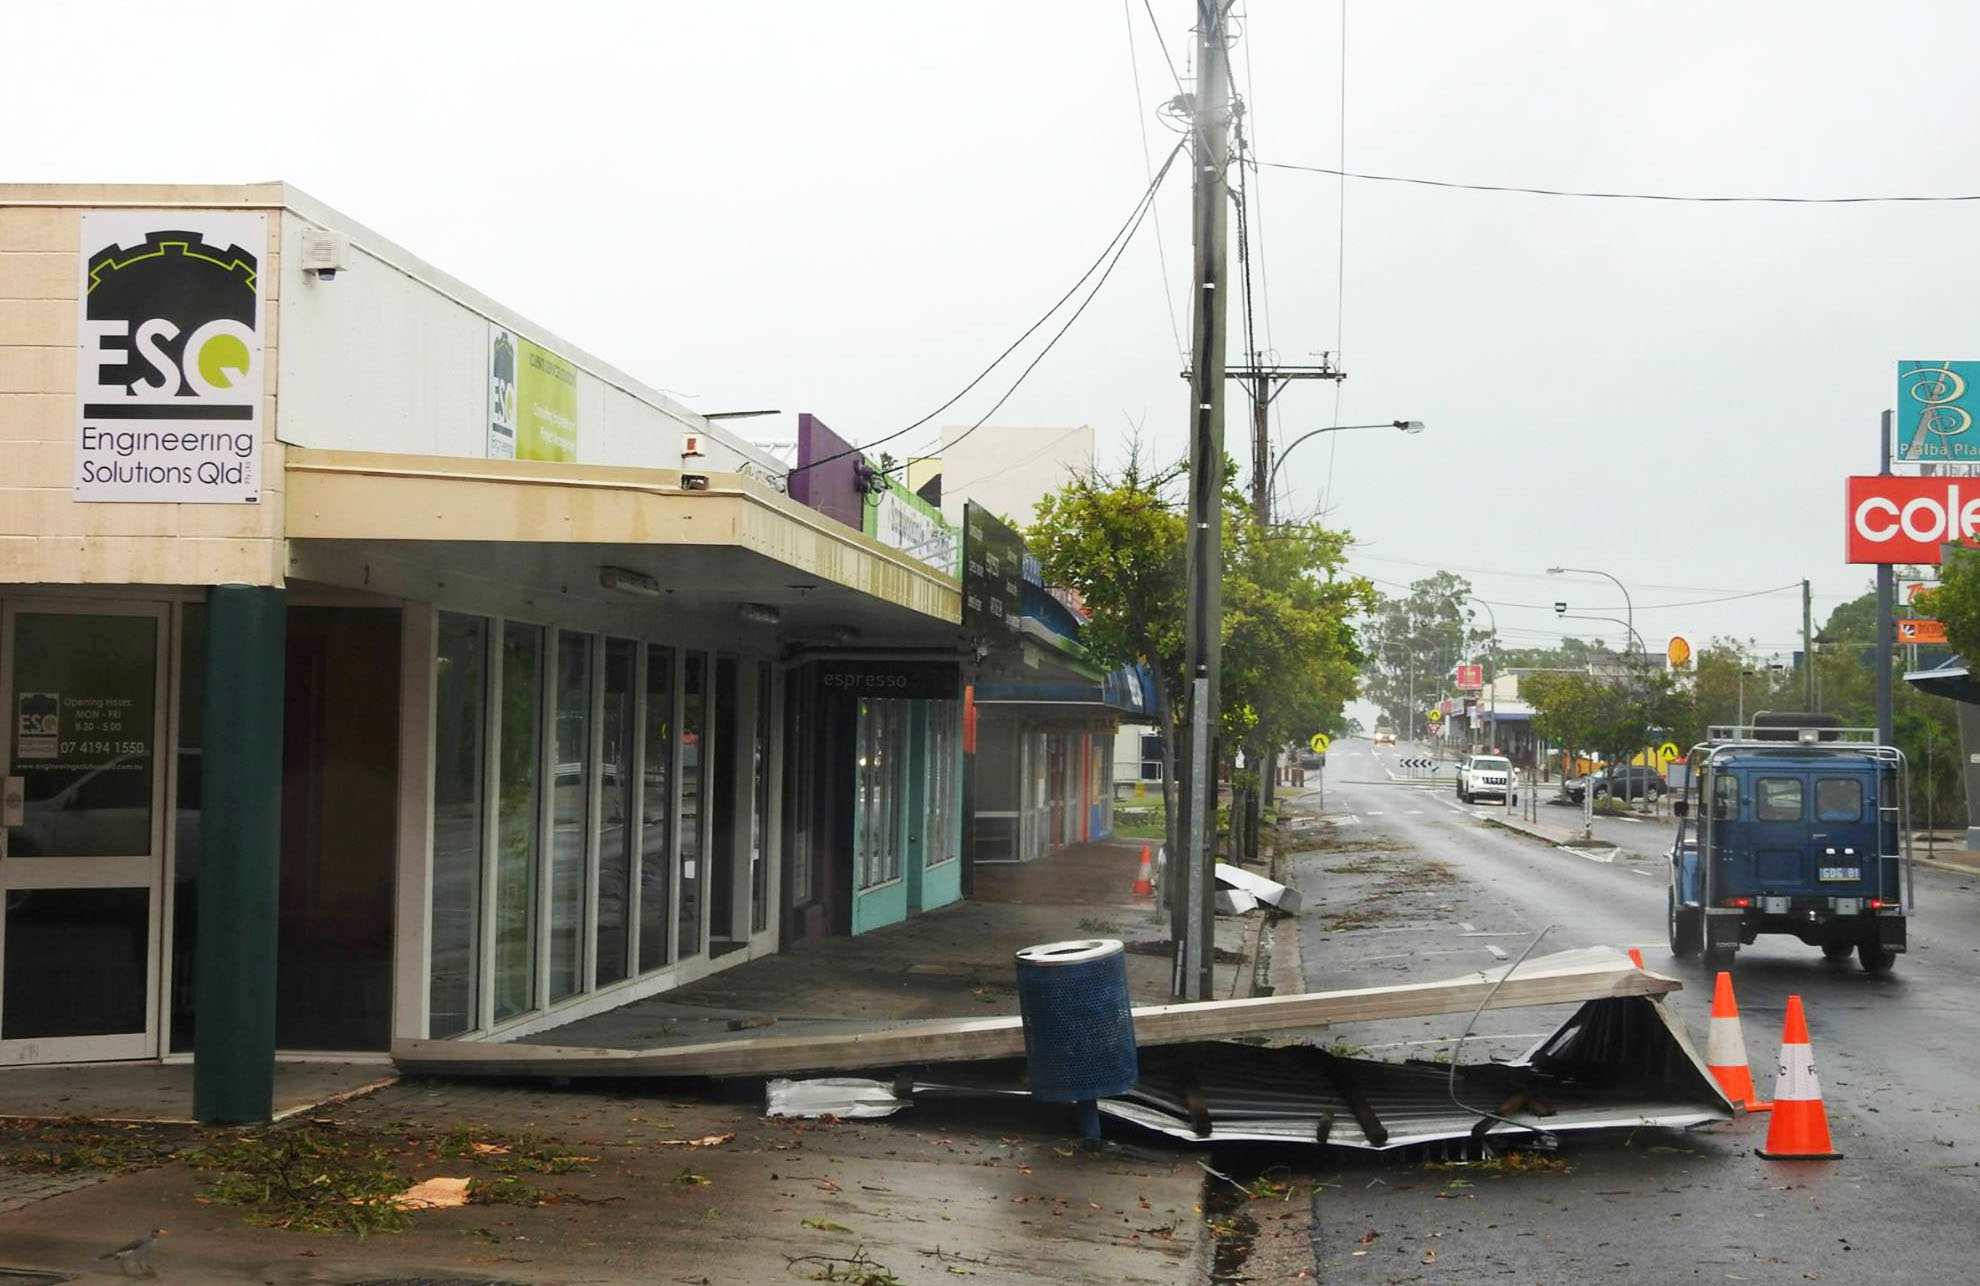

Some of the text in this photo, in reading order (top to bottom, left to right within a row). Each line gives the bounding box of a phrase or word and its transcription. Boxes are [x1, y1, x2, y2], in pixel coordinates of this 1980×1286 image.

[86, 318, 257, 397] ESQ
[82, 426, 253, 457] Engineering
[1900, 443, 1980, 455] Palba Pla
[82, 460, 243, 485] Solutions Qld
[824, 673, 907, 690] espresso
[63, 697, 104, 708] Opening
[75, 710, 100, 719] MON
[108, 710, 121, 719] FRI
[20, 714, 58, 734] ESQ
[60, 741, 76, 754] 07
[79, 741, 110, 754] 4194
[115, 741, 144, 754] 1550
